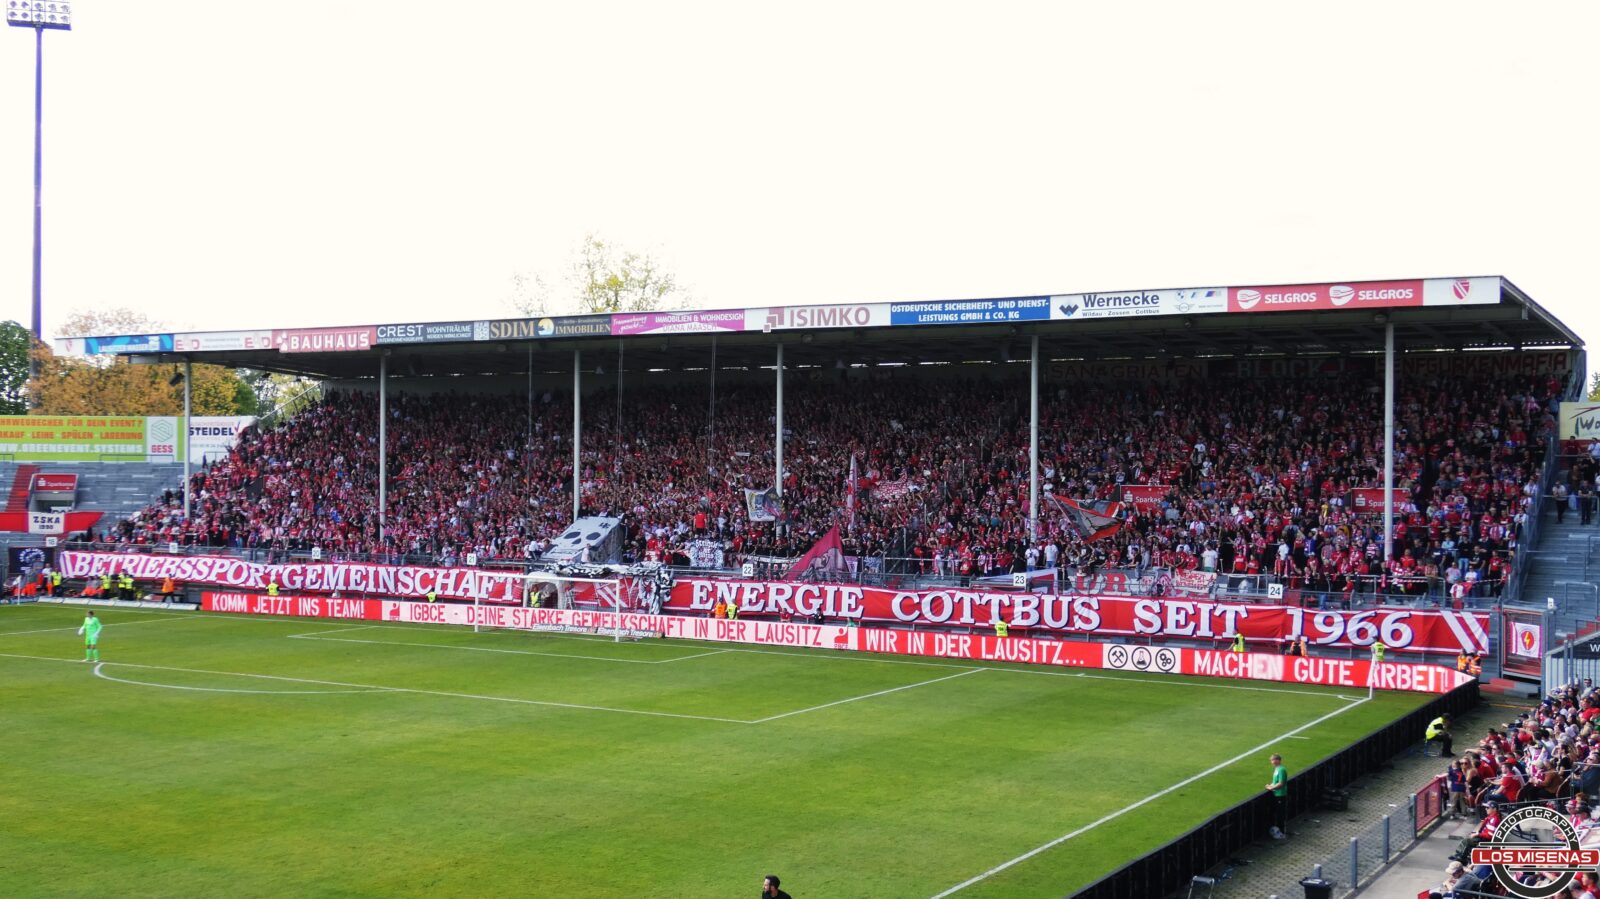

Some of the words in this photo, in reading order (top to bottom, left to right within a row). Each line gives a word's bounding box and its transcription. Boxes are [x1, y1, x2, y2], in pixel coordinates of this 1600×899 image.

[1083, 291, 1160, 308] Wernecke
[1264, 292, 1317, 304] SELGROS
[1358, 288, 1413, 301] SELGROS
[892, 302, 943, 313] OSTDEUTSCHE
[944, 301, 996, 311] SICHERHEITS-
[998, 300, 1015, 310] UND
[1018, 299, 1049, 309] DIENST-
[700, 313, 744, 321] WOHNDESIGN
[790, 306, 871, 327] ISIMKO
[918, 313, 958, 322] LEISTUNGS
[960, 312, 982, 321] GMBH
[985, 312, 991, 320] &
[993, 311, 1006, 320] CO.
[1008, 311, 1020, 319] KG
[377, 325, 424, 338] CREST
[426, 324, 472, 333] WOHNTRÄUME
[490, 321, 535, 338] SDIM
[555, 324, 611, 335] IMMOBILIEN
[291, 333, 370, 349] BAUHAUS
[67, 416, 83, 427] FÜR
[189, 427, 234, 436] STEIDEL
[151, 444, 174, 453] GESS
[33, 516, 60, 524] ZSKA
[743, 566, 752, 575] 22
[1015, 575, 1025, 585] 23
[1270, 586, 1281, 596] 24
[212, 593, 247, 611] KOMM
[253, 595, 291, 614] JETZT
[299, 597, 325, 616] INS
[328, 599, 365, 618] TEAM!
[690, 580, 865, 618] ENERGIE
[891, 591, 1101, 631] COTTBUS
[1133, 599, 1248, 638] SEIT
[1285, 608, 1413, 648] 1966
[409, 604, 446, 622] IGBCE
[467, 606, 505, 626] DEINE
[512, 608, 564, 629] STARKE
[694, 619, 708, 638] IN
[716, 620, 746, 641] DER
[754, 623, 822, 646] LAUSITZ
[865, 629, 897, 652] WIR
[907, 632, 925, 654] IN
[935, 634, 971, 658] DER
[1194, 651, 1284, 681] MACHEN
[1294, 658, 1354, 685] GUTE
